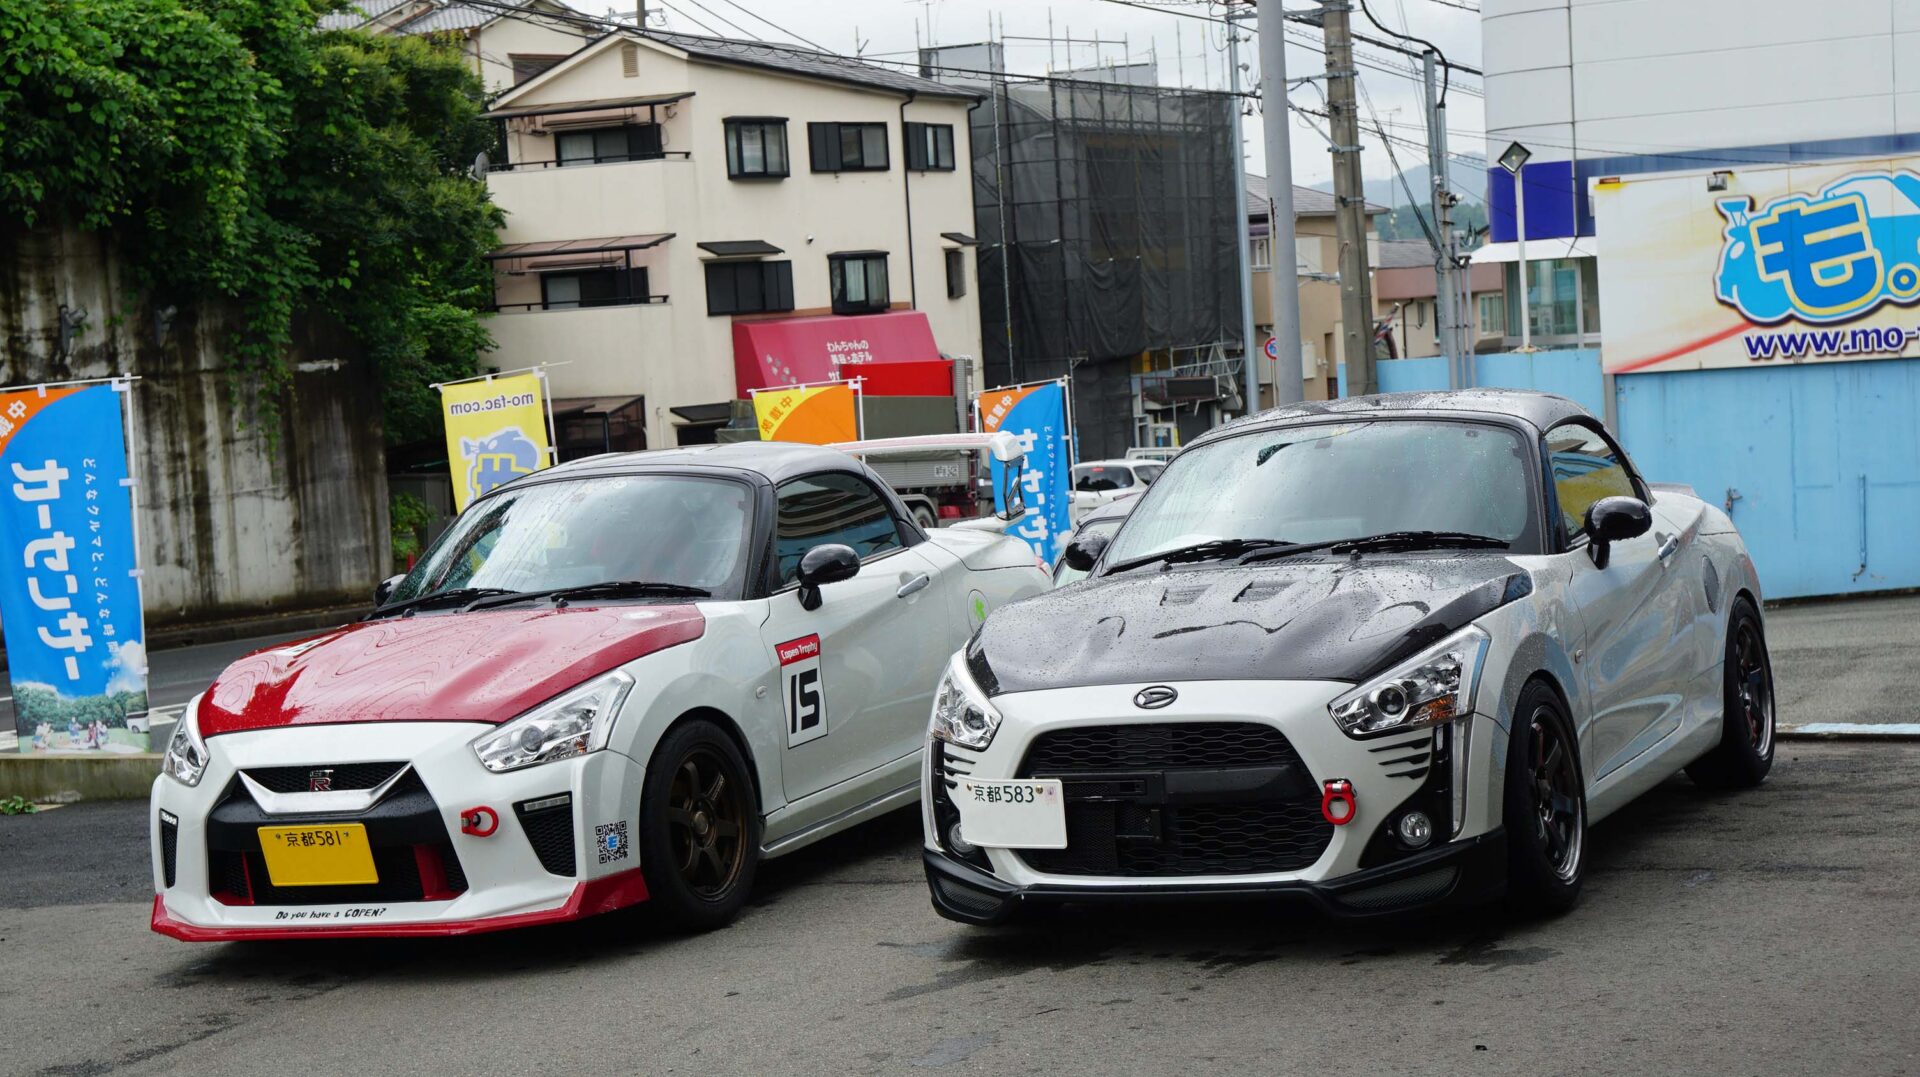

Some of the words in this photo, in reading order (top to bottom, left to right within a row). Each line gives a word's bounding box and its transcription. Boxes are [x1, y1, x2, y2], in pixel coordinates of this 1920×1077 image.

[827, 340, 869, 352] わんちゃんの
[1745, 326, 1920, 356] www.mo-
[11, 459, 93, 680] カーセンサー
[781, 648, 799, 660] Copen
[798, 641, 818, 655] Trophy
[790, 668, 820, 734] 15
[310, 777, 332, 792] R
[275, 911, 289, 919] Do
[290, 912, 308, 920] you
[309, 911, 331, 919] have
[344, 907, 387, 918] COPEN?
